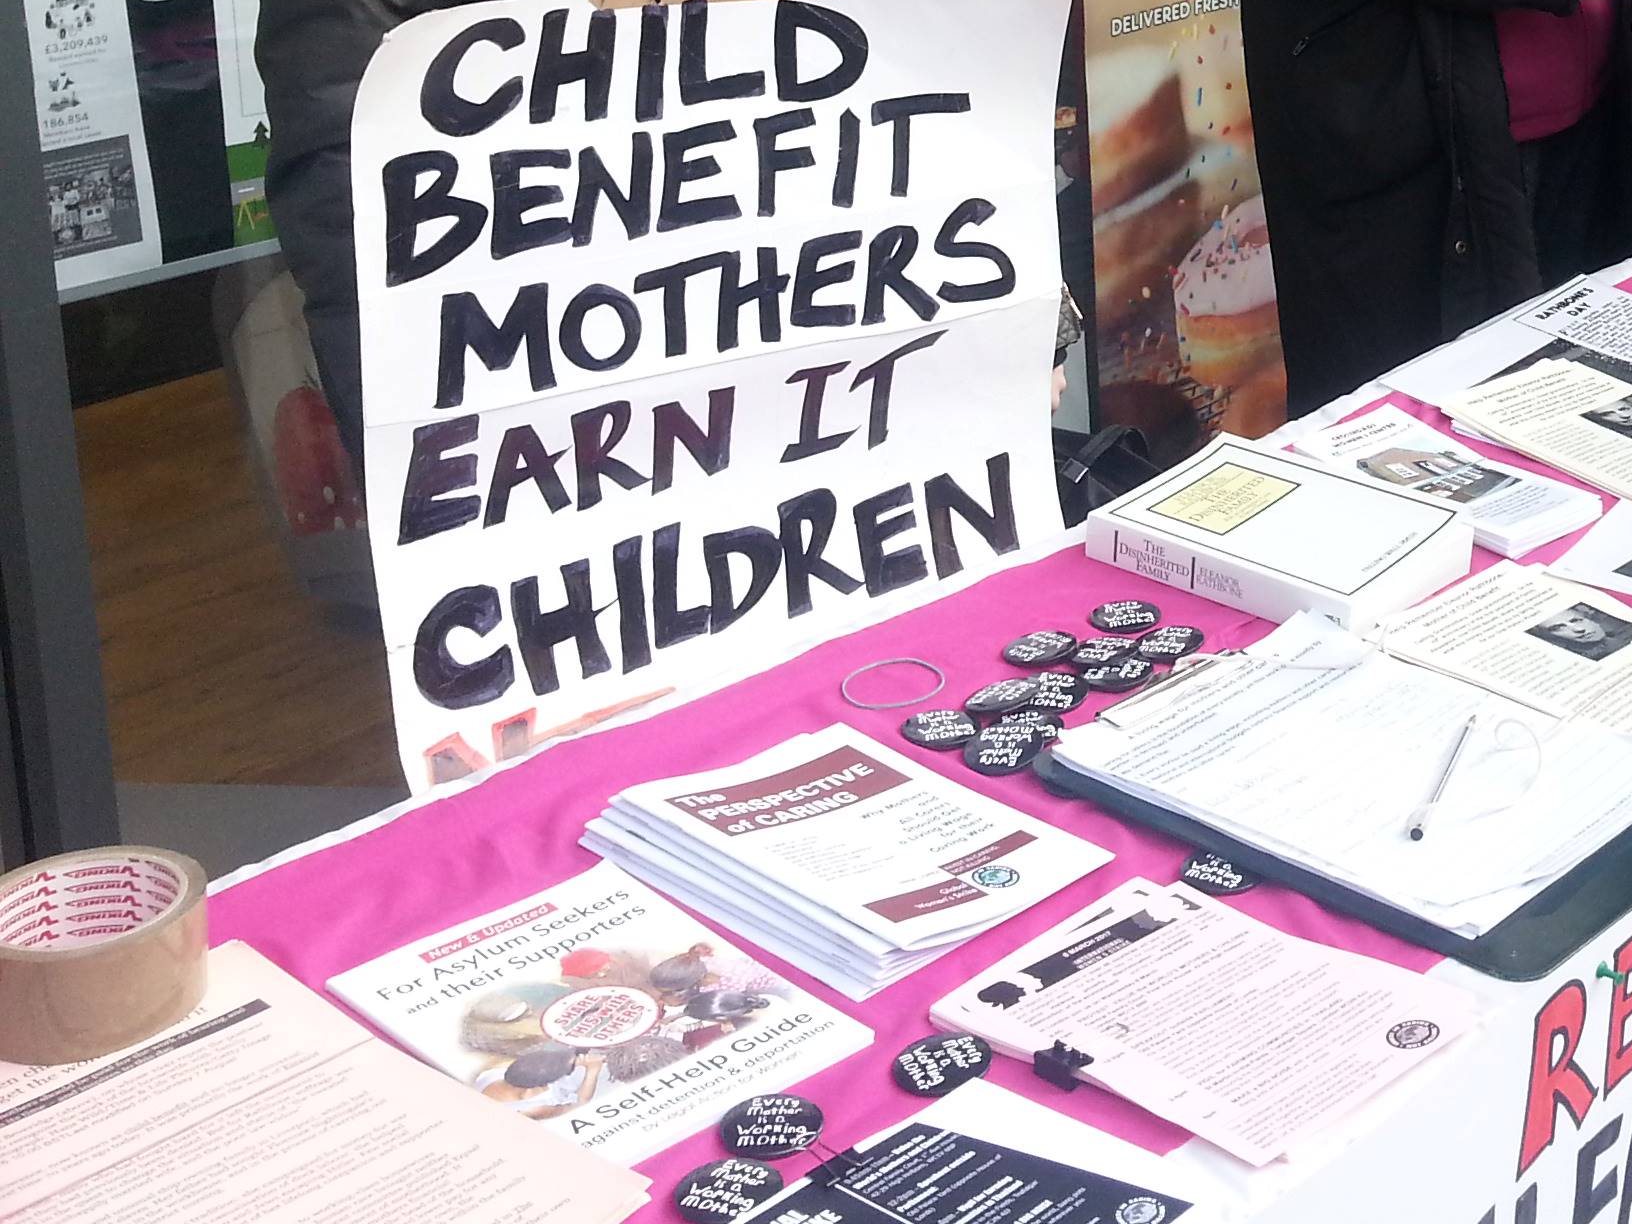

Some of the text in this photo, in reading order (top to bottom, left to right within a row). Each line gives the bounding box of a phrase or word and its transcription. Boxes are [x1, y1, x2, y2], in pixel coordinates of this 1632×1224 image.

[1110, 0, 1191, 37] DELIVERED
[381, 92, 971, 289] BENEFIT
[435, 198, 1016, 409] MOTHERS
[1566, 302, 1592, 317] DAY
[397, 328, 949, 547] EARN IT
[412, 451, 1020, 711] CHILDREN
[674, 791, 727, 809] The
[697, 761, 876, 822] PERSPECTIVE
[727, 791, 860, 834] of CARING
[375, 889, 630, 1001] For Asylum Seekers
[428, 904, 550, 960] New & Updated
[406, 905, 647, 1015] and their Supporters
[554, 994, 601, 1025] SHARE
[593, 1003, 646, 1041] OTHERS
[957, 1036, 983, 1064] Every
[569, 1011, 814, 1135] A Self-Help Guide
[580, 1113, 645, 1149] against
[647, 1074, 727, 1116] detention
[744, 1019, 836, 1069] deportation
[747, 1105, 804, 1116] Mother
[751, 1097, 800, 1108] Every
[736, 1124, 808, 1136] Working
[710, 1167, 766, 1186] Mother
[722, 1159, 769, 1179] Every
[689, 1182, 755, 1213] Working
